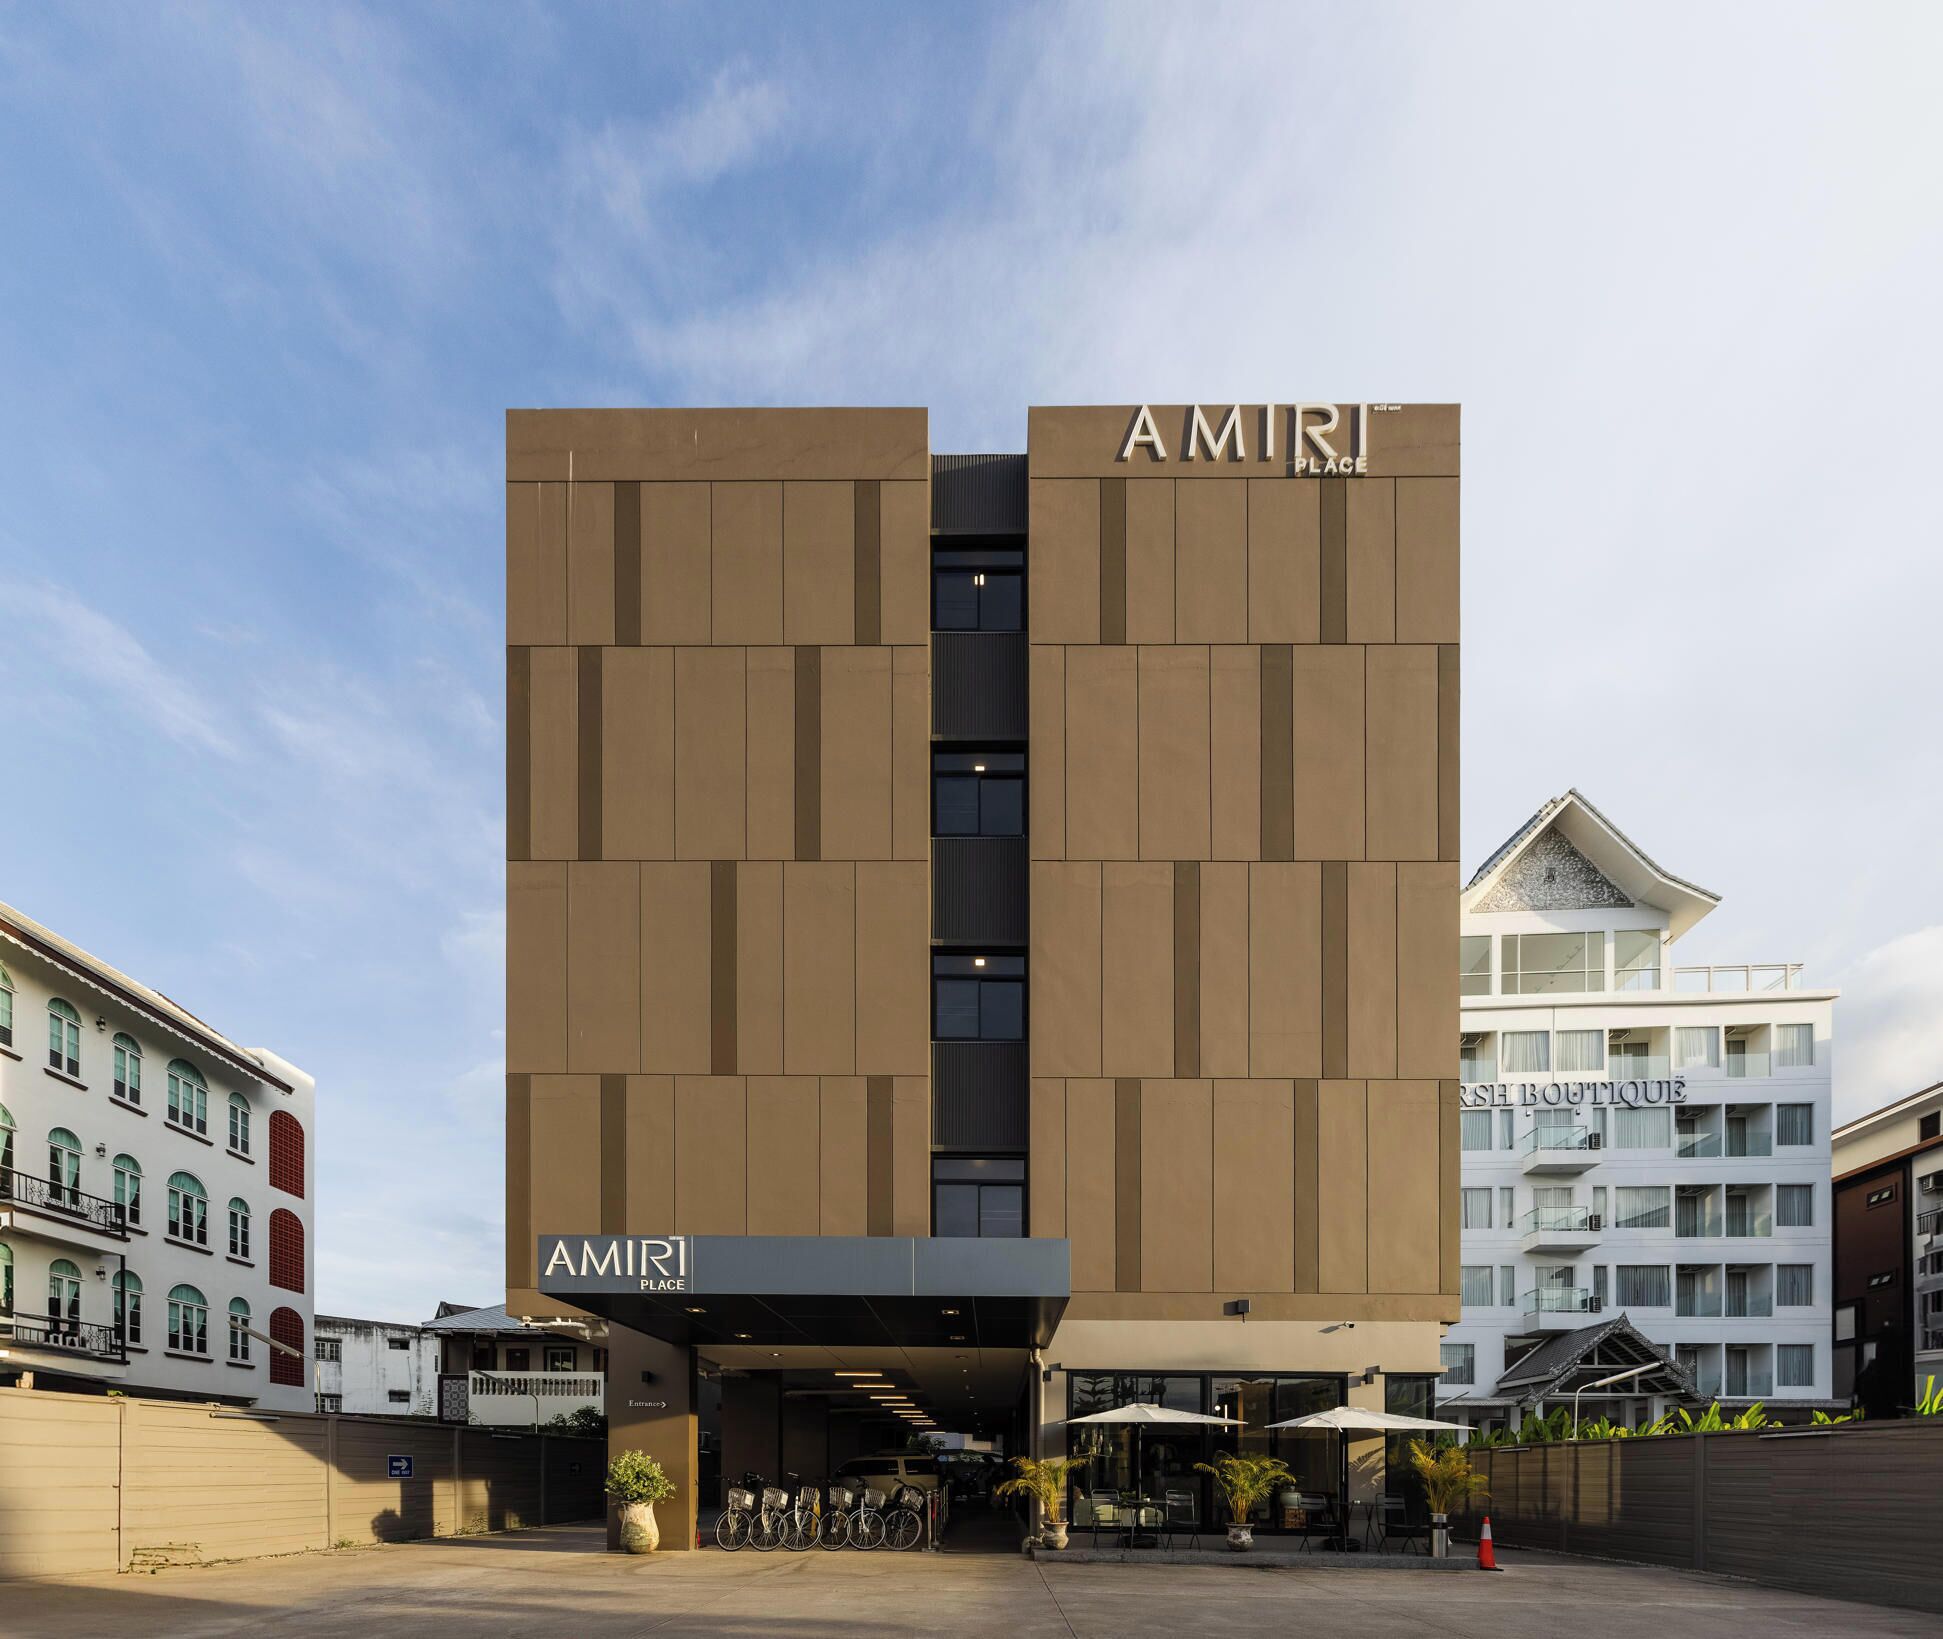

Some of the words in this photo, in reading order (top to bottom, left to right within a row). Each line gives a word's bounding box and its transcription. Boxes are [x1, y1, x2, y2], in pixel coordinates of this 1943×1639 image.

[1121, 402, 1368, 461] AMIRI
[1294, 456, 1368, 476] PLACE
[1521, 1080, 1688, 1110] BOUTIQUE
[544, 1239, 686, 1277] AMIRI
[640, 1279, 686, 1291] PLACE
[629, 1399, 661, 1407] Entrance
